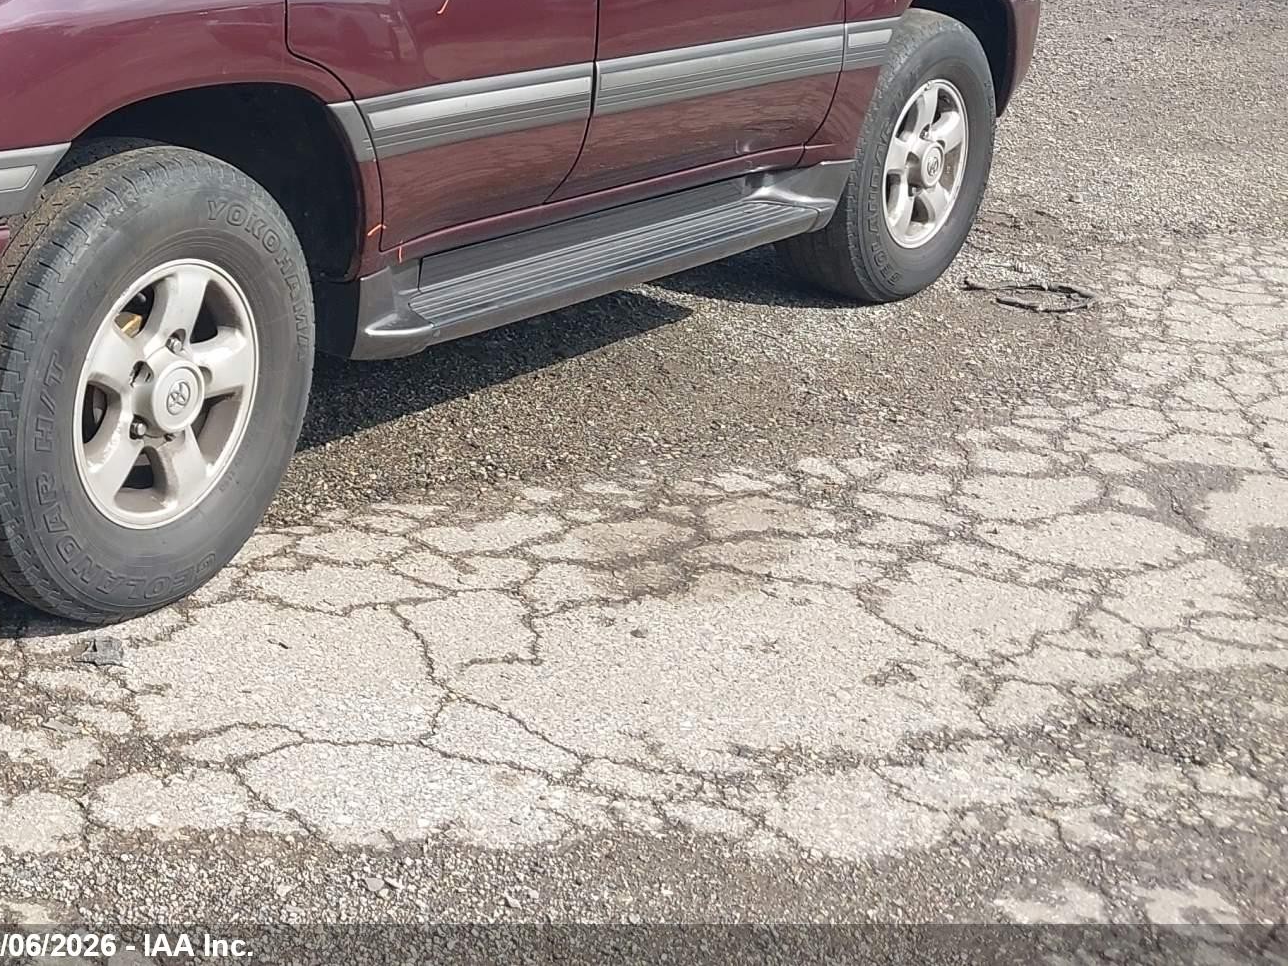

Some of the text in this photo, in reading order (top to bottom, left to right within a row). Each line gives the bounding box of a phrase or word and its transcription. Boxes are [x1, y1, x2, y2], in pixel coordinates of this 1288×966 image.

[207, 199, 310, 363] YOKOHAMA
[34, 350, 216, 600] GEOLANDAR H/T
